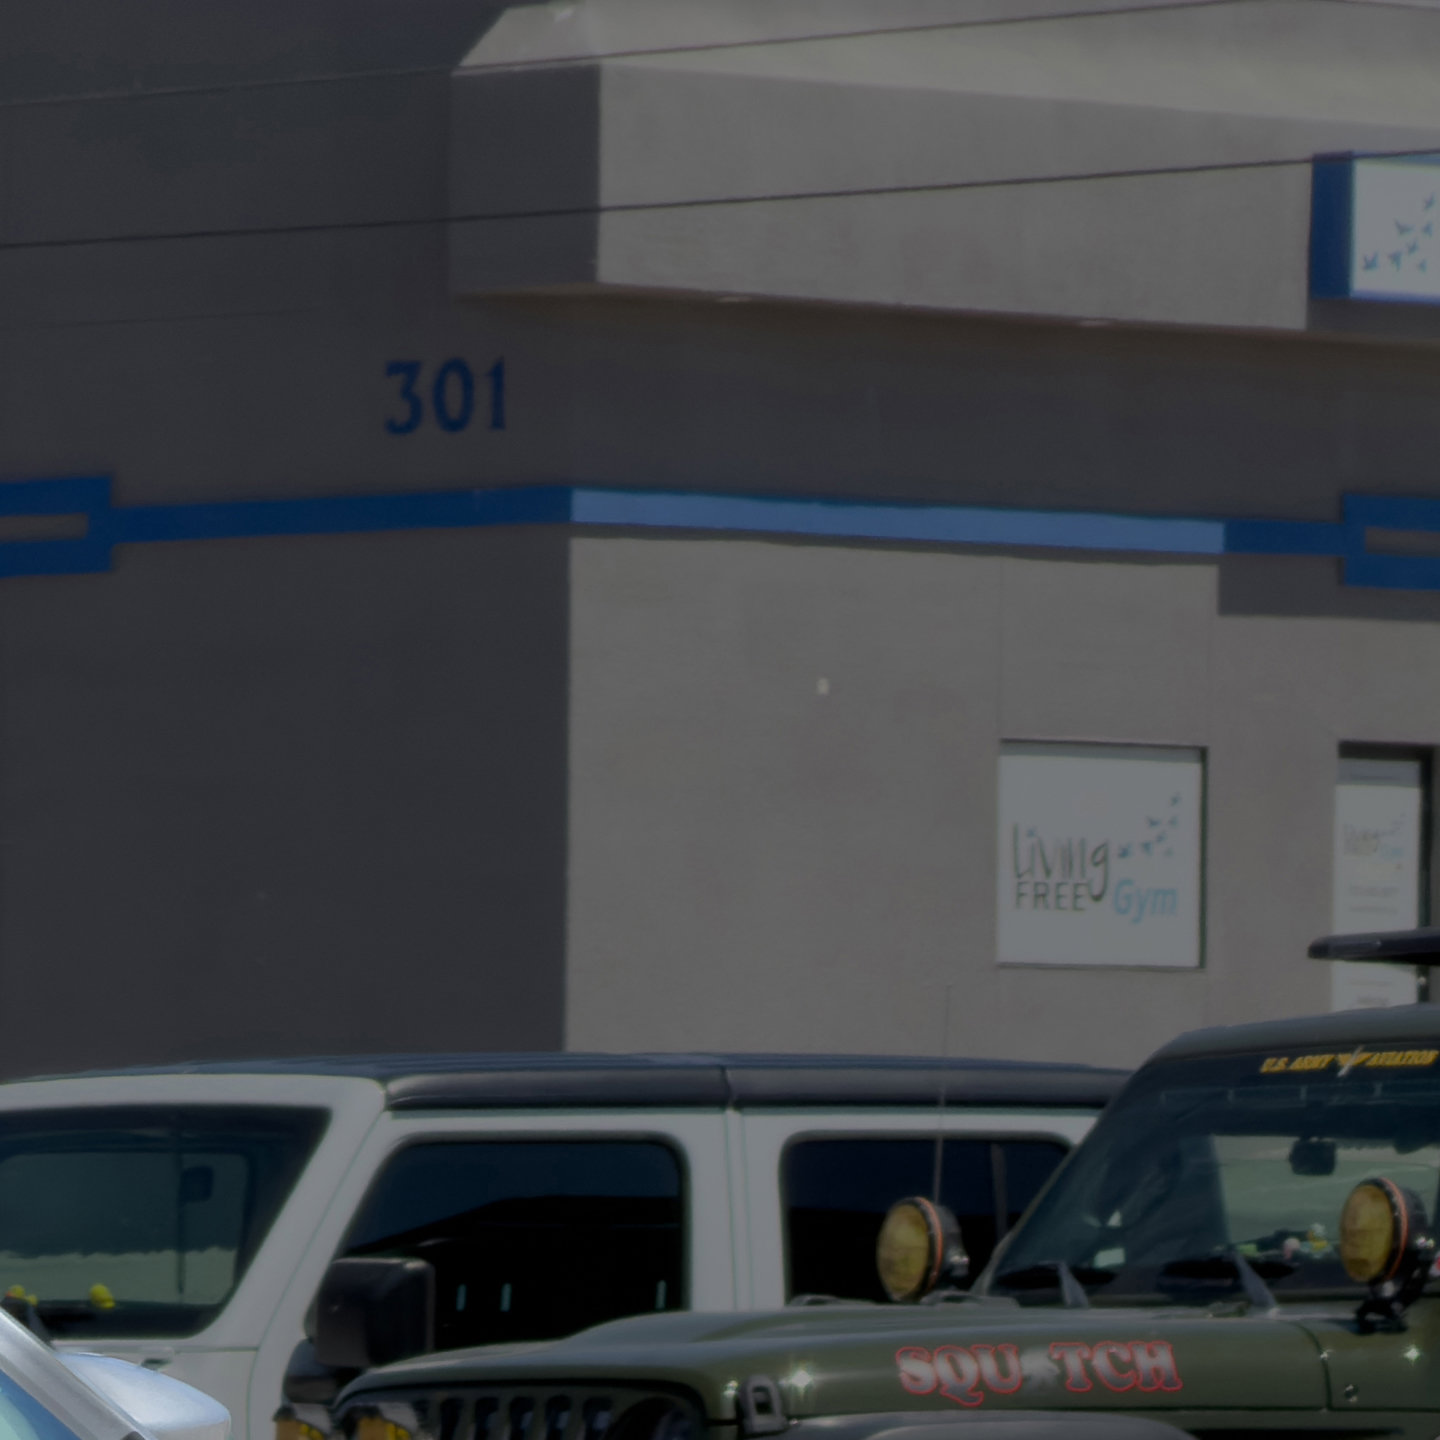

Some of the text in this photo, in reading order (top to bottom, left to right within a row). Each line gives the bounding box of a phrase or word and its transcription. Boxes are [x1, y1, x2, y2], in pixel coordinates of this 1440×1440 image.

[384, 356, 507, 436] 301
[1015, 878, 1178, 924] FREE Gym
